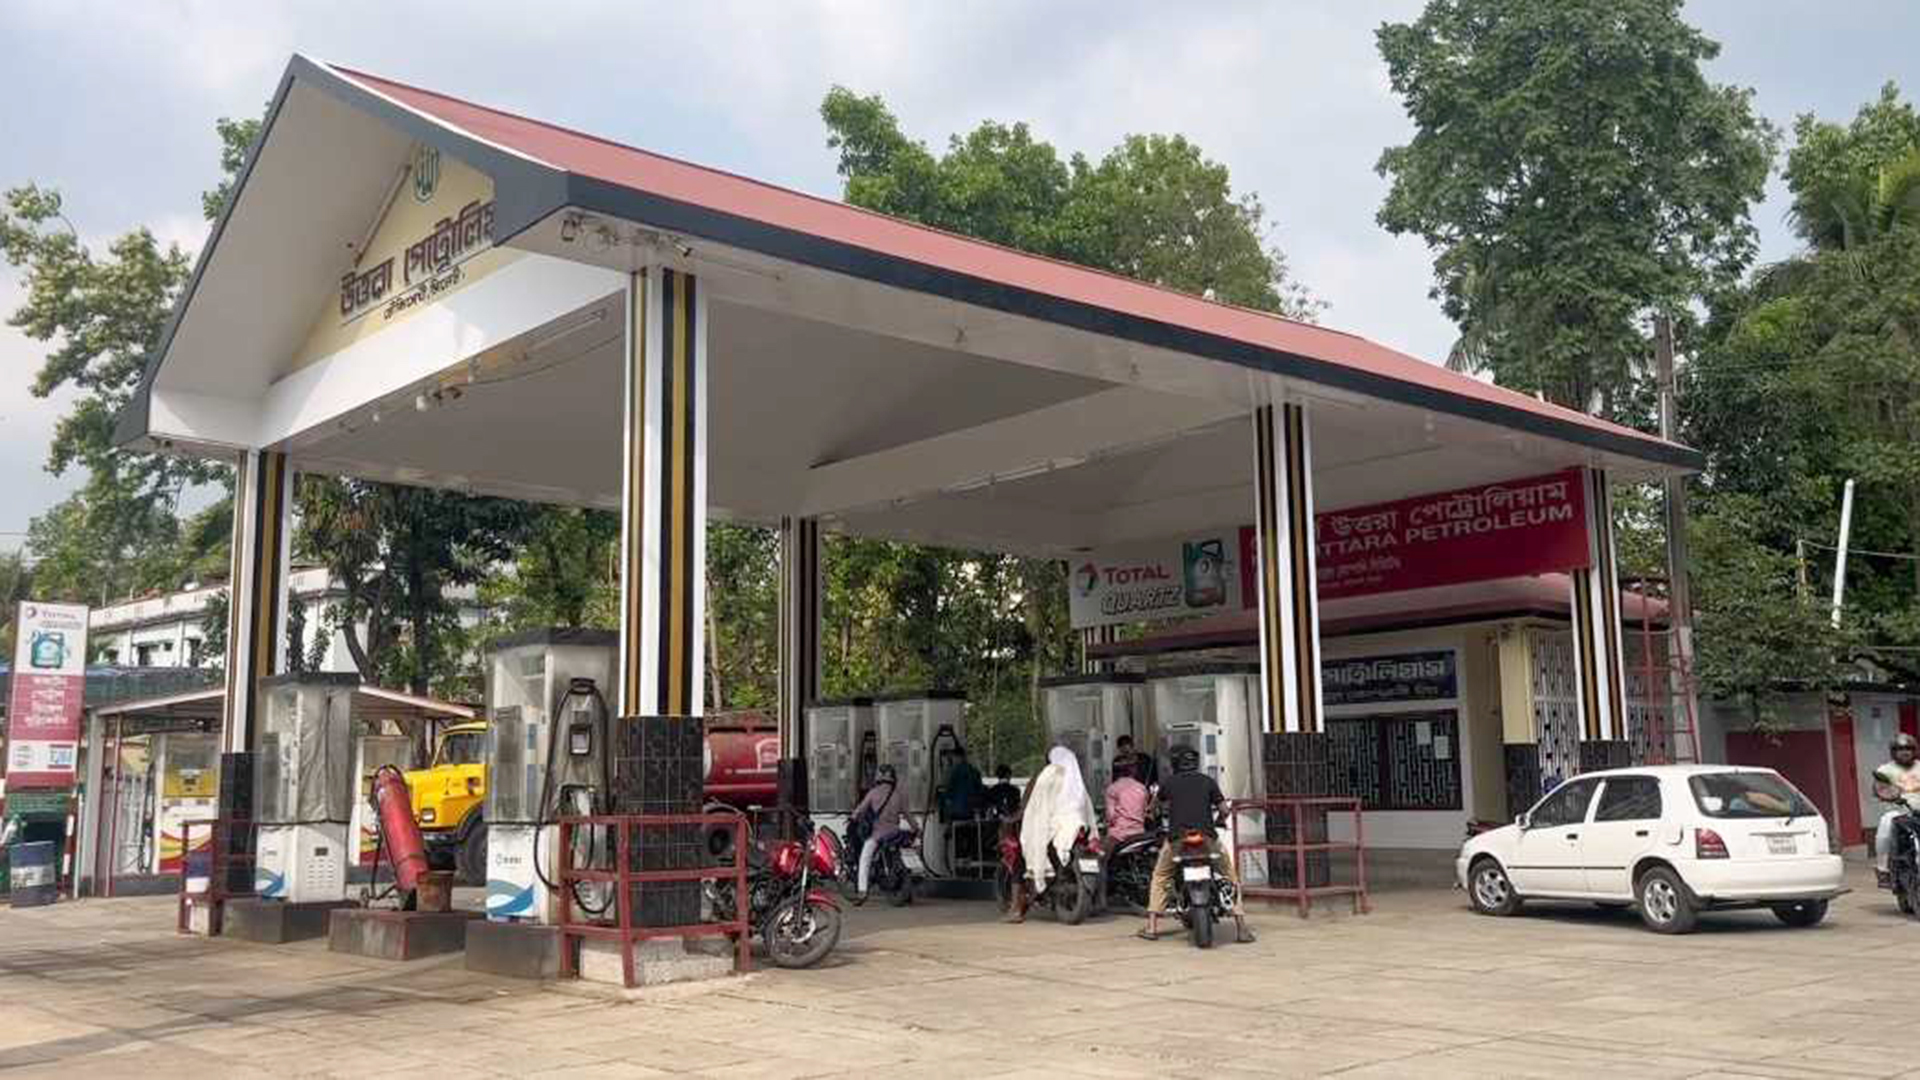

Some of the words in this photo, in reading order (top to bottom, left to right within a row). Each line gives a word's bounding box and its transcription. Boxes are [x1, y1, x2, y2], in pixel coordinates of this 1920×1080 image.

[1409, 480, 1569, 526] পেট্রোলিয়াম
[1317, 531, 1398, 557] TTARA
[1405, 505, 1574, 544] PETROLEUM
[1102, 564, 1170, 584] TOTAL
[1100, 585, 1184, 615] QUARTZ
